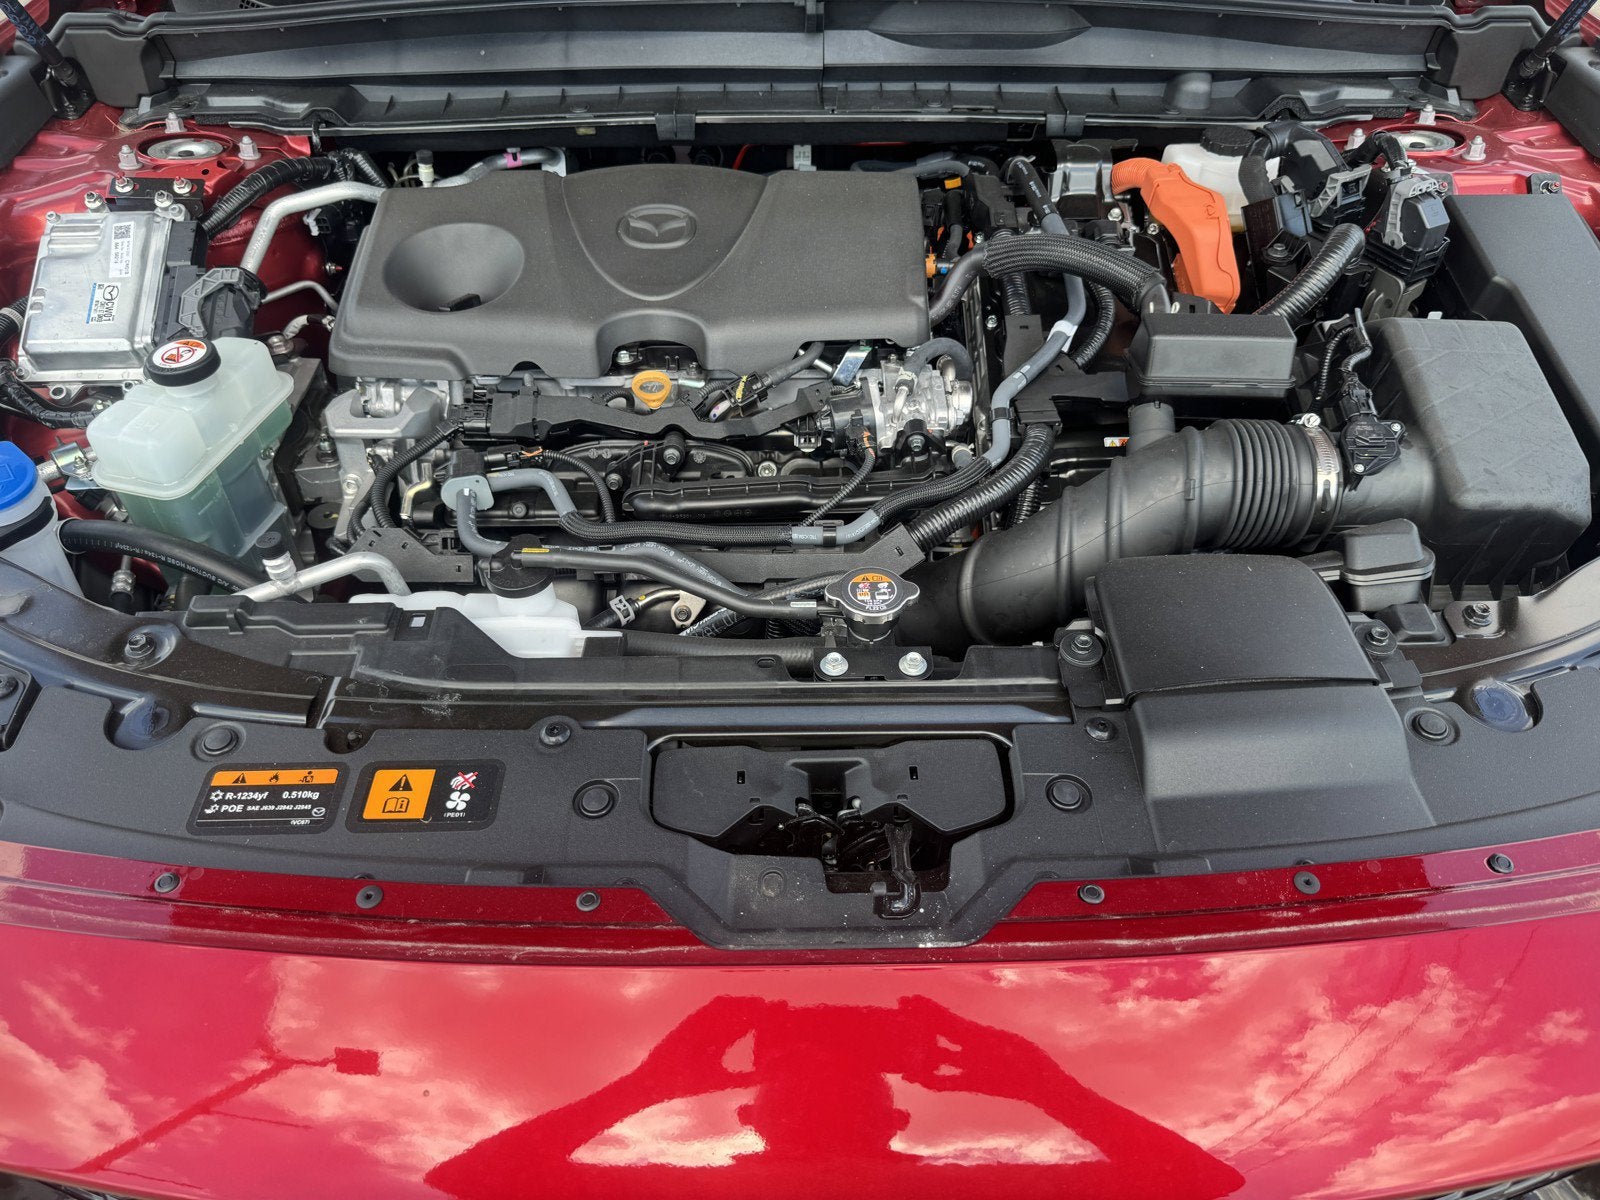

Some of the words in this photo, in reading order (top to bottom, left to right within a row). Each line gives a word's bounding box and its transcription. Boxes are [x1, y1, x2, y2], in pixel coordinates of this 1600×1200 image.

[103, 301, 115, 321] CW01
[167, 556, 186, 568] HOSE
[186, 564, 216, 581] SUCTION
[217, 578, 230, 587] A/C
[225, 791, 269, 801] R-1234yf
[282, 791, 320, 800] 0.510kg
[220, 805, 245, 813] POE
